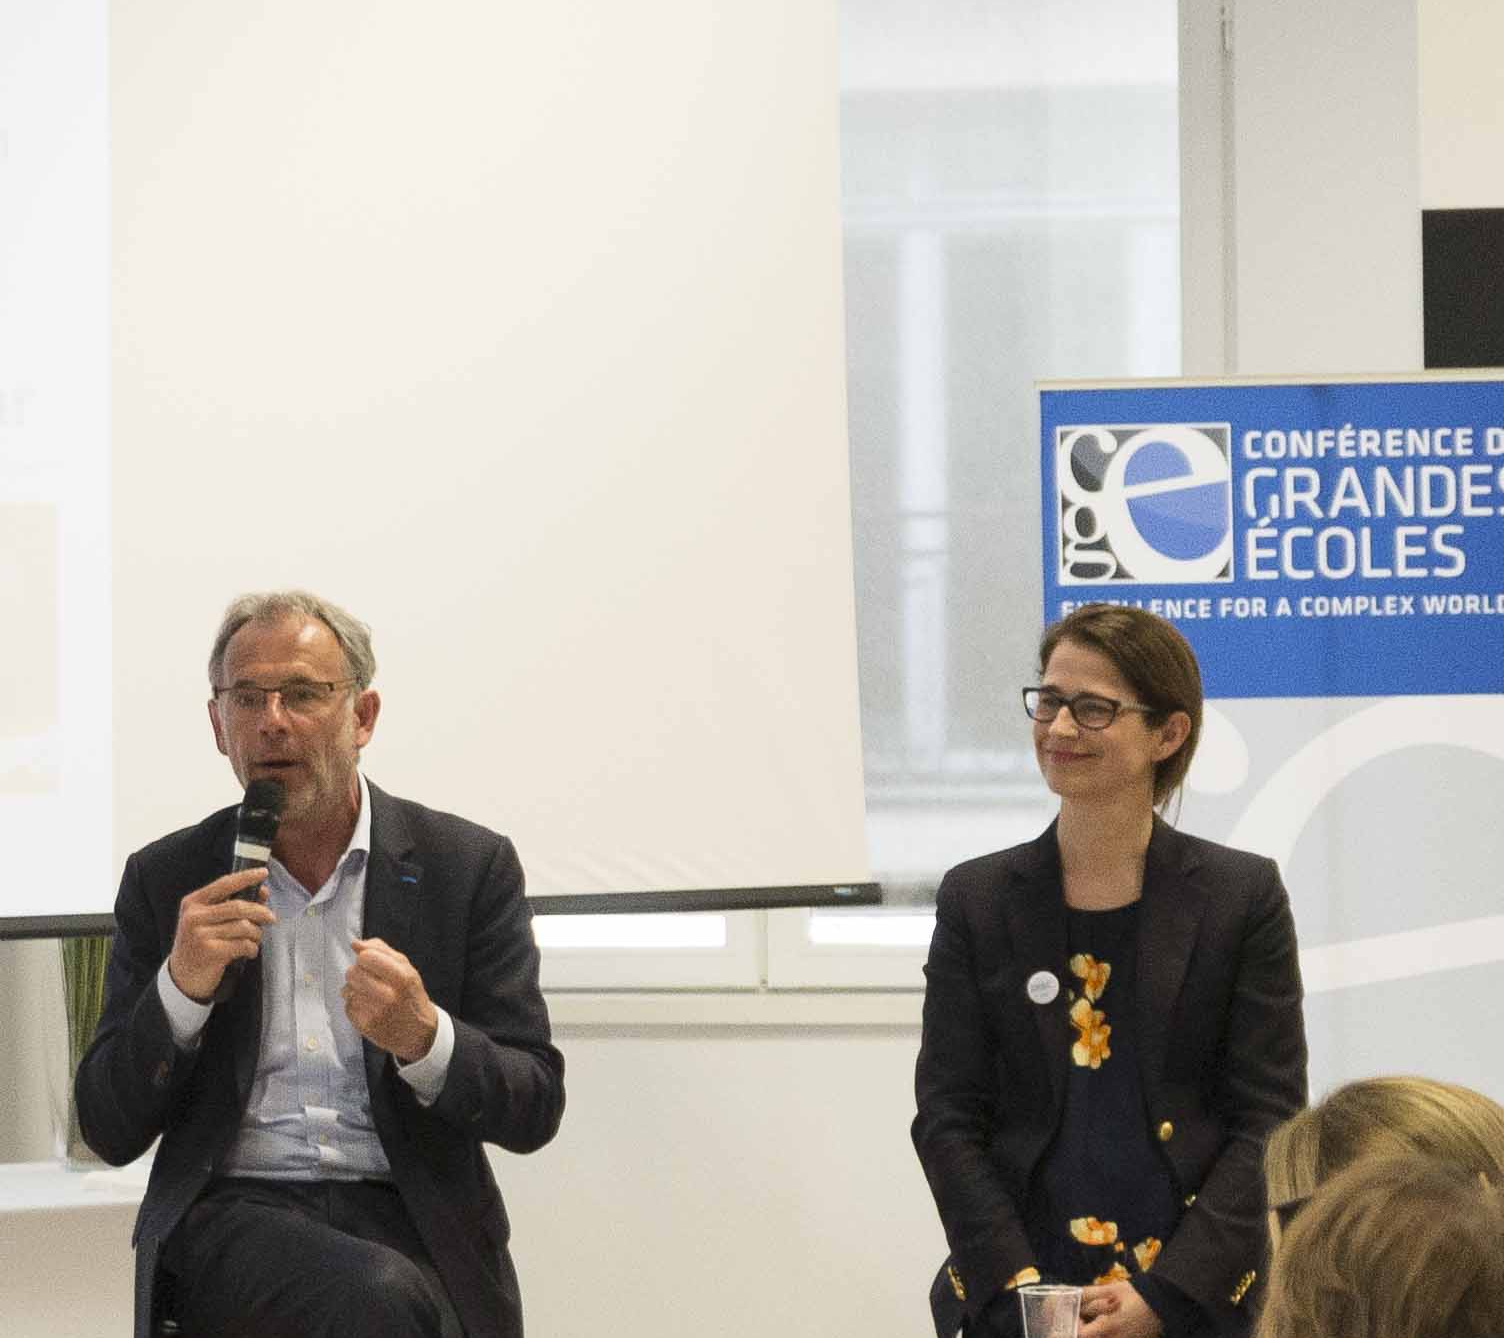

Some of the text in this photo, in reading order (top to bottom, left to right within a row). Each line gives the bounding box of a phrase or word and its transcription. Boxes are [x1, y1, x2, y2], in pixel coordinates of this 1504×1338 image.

[1243, 424, 1473, 459] CONFÉRENCE
[1246, 516, 1465, 579] ÉCOLES
[1219, 598, 1267, 617] FOR
[1275, 597, 1292, 616] A
[1299, 596, 1414, 616] COMPLEX
